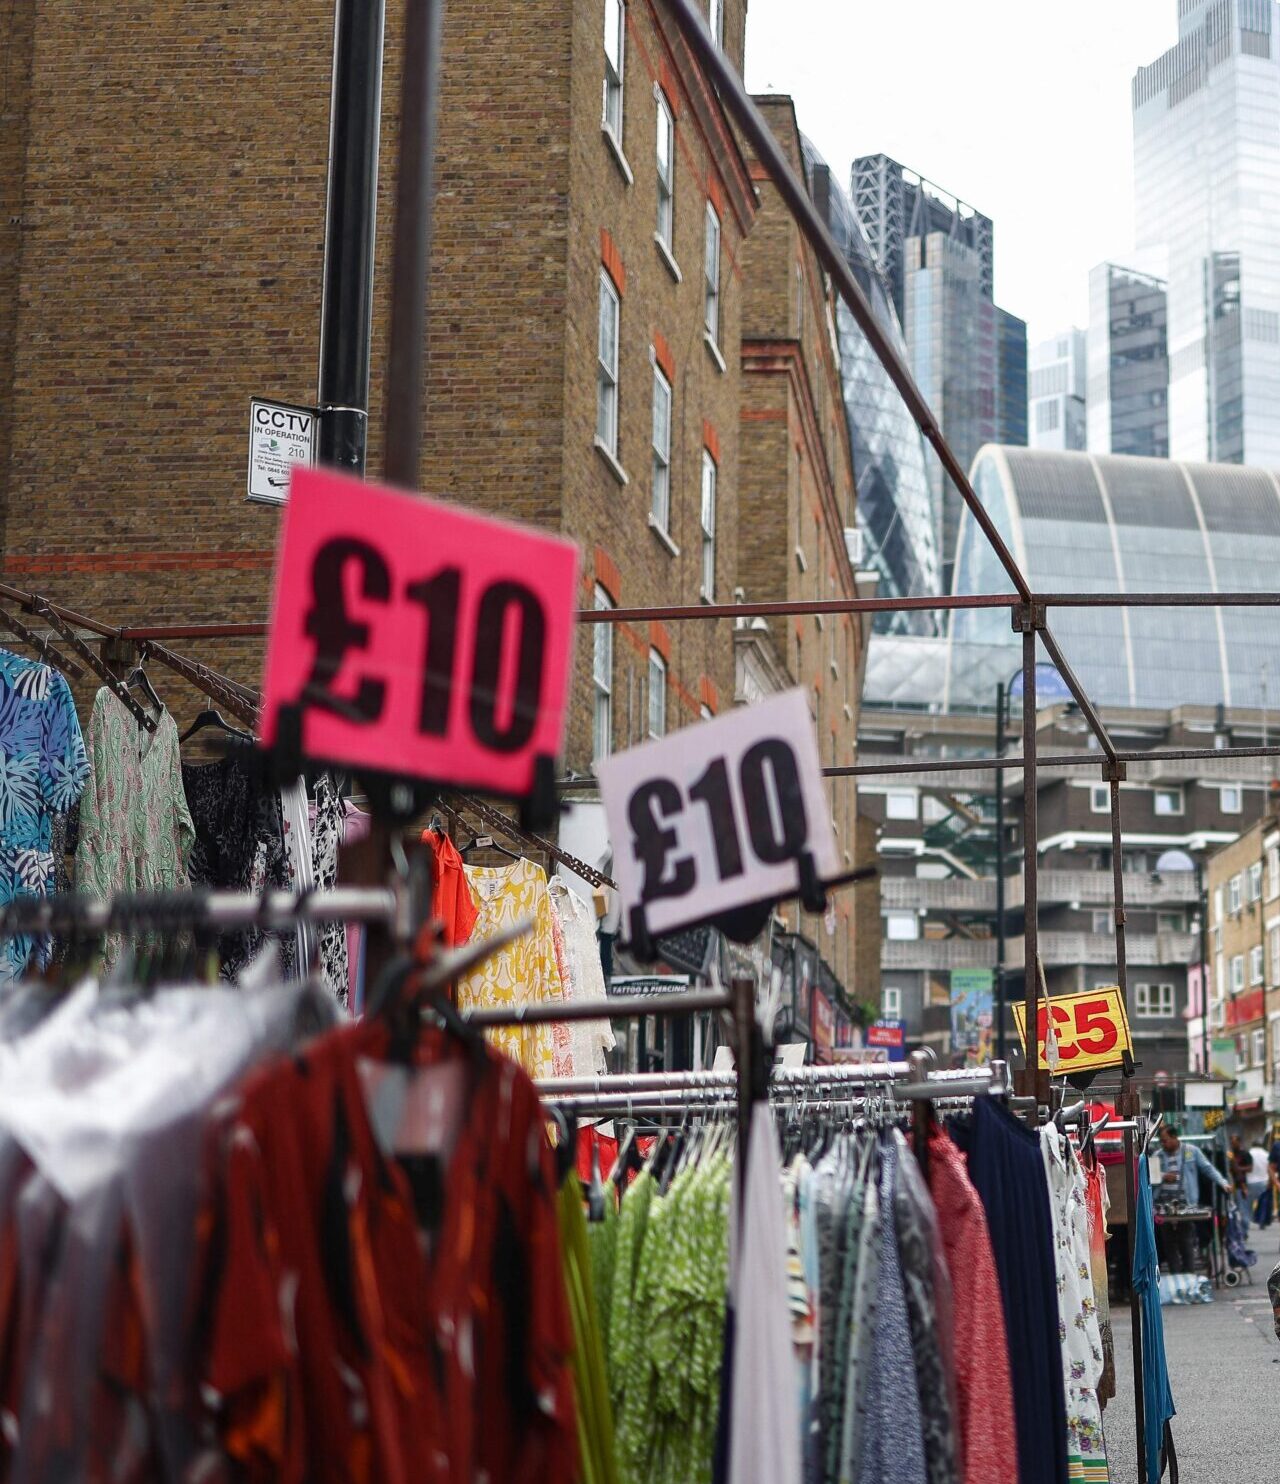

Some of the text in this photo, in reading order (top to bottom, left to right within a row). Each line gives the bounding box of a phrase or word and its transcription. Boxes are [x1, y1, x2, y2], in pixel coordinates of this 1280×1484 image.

[256, 408, 310, 433] CCTV
[254, 426, 310, 444] IN OPERATION
[288, 447, 305, 459] 210
[302, 534, 549, 754] £10
[627, 737, 808, 903] £10
[612, 986, 641, 995] TATTOO
[650, 985, 688, 993] PIERCING
[1037, 999, 1118, 1062] £5
